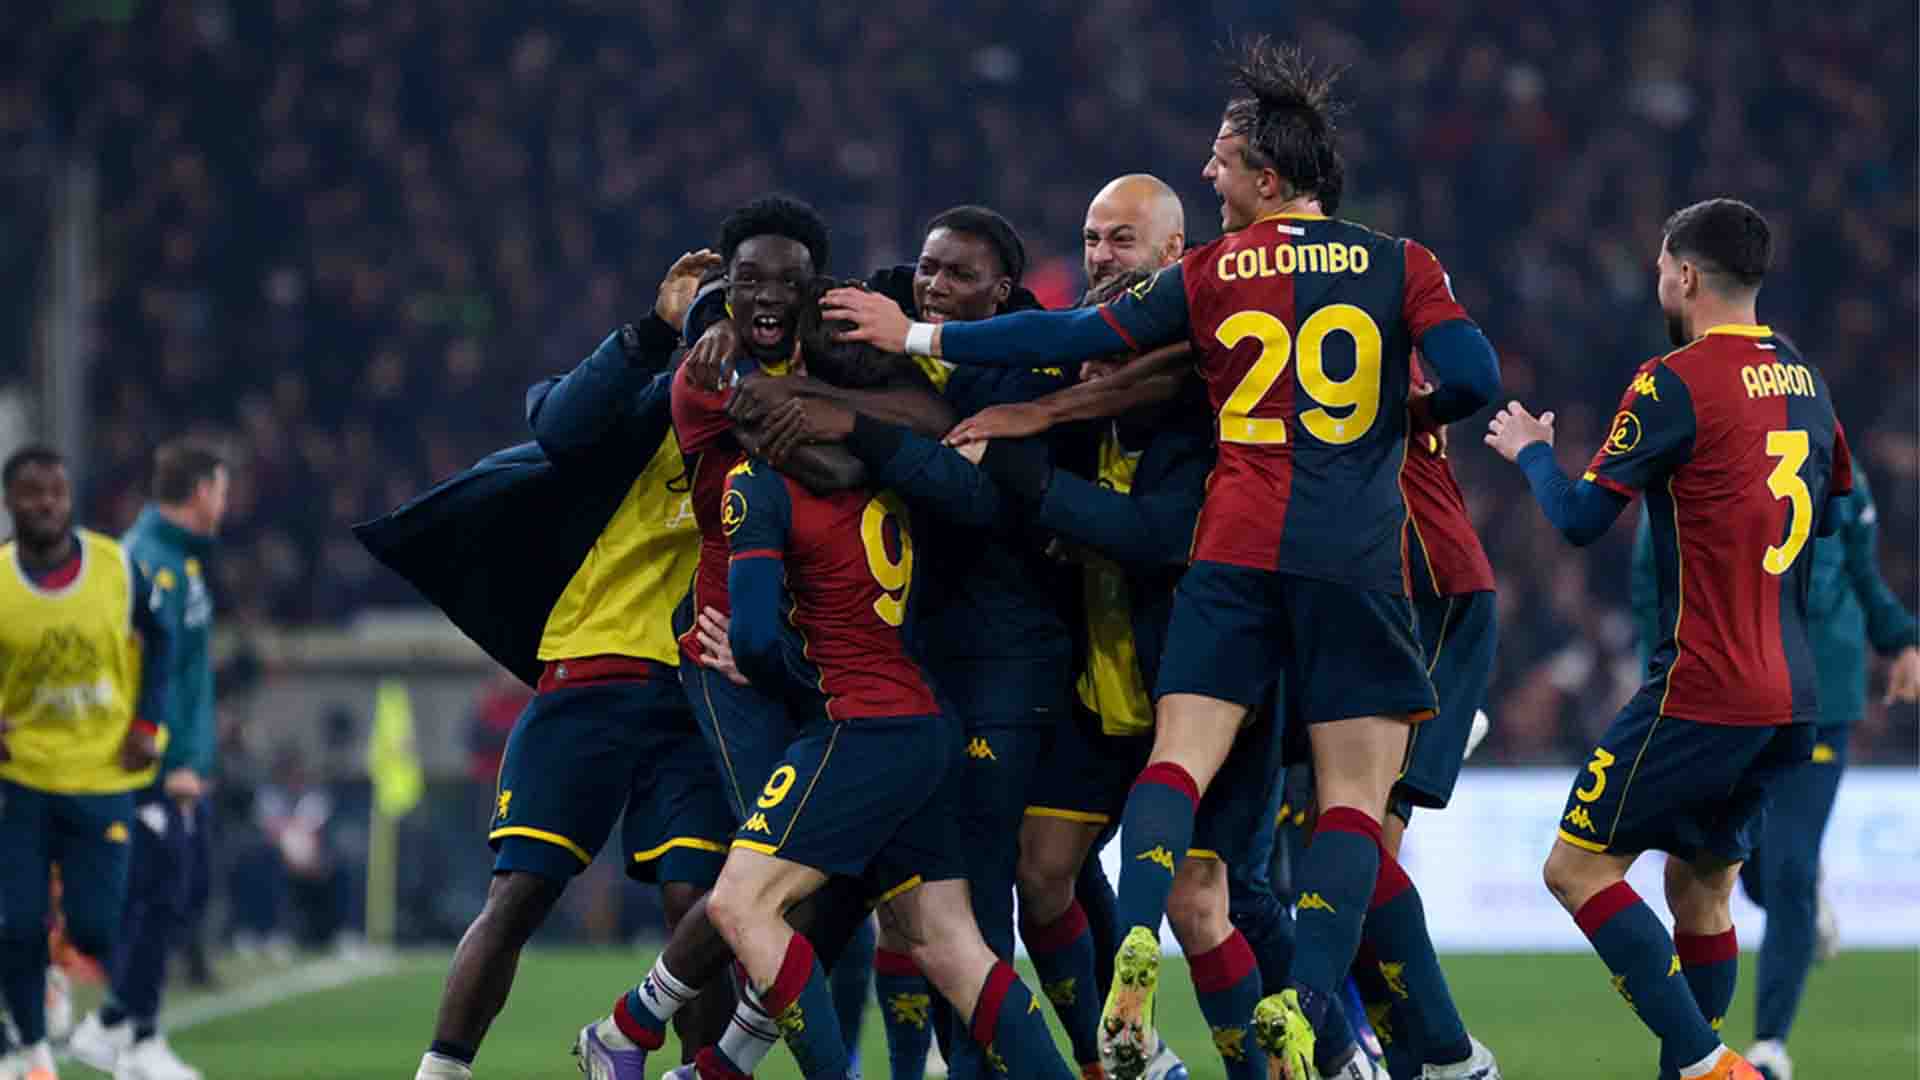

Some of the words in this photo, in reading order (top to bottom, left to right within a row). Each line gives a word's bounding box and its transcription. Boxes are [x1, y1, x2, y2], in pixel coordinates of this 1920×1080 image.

[1217, 242, 1369, 281] COLOMBO
[1215, 304, 1382, 444] 29
[1741, 362, 1816, 399] AARON
[1762, 430, 1813, 575] 3
[860, 495, 913, 626] 9
[757, 765, 797, 809] 9
[1576, 747, 1615, 802] 3
